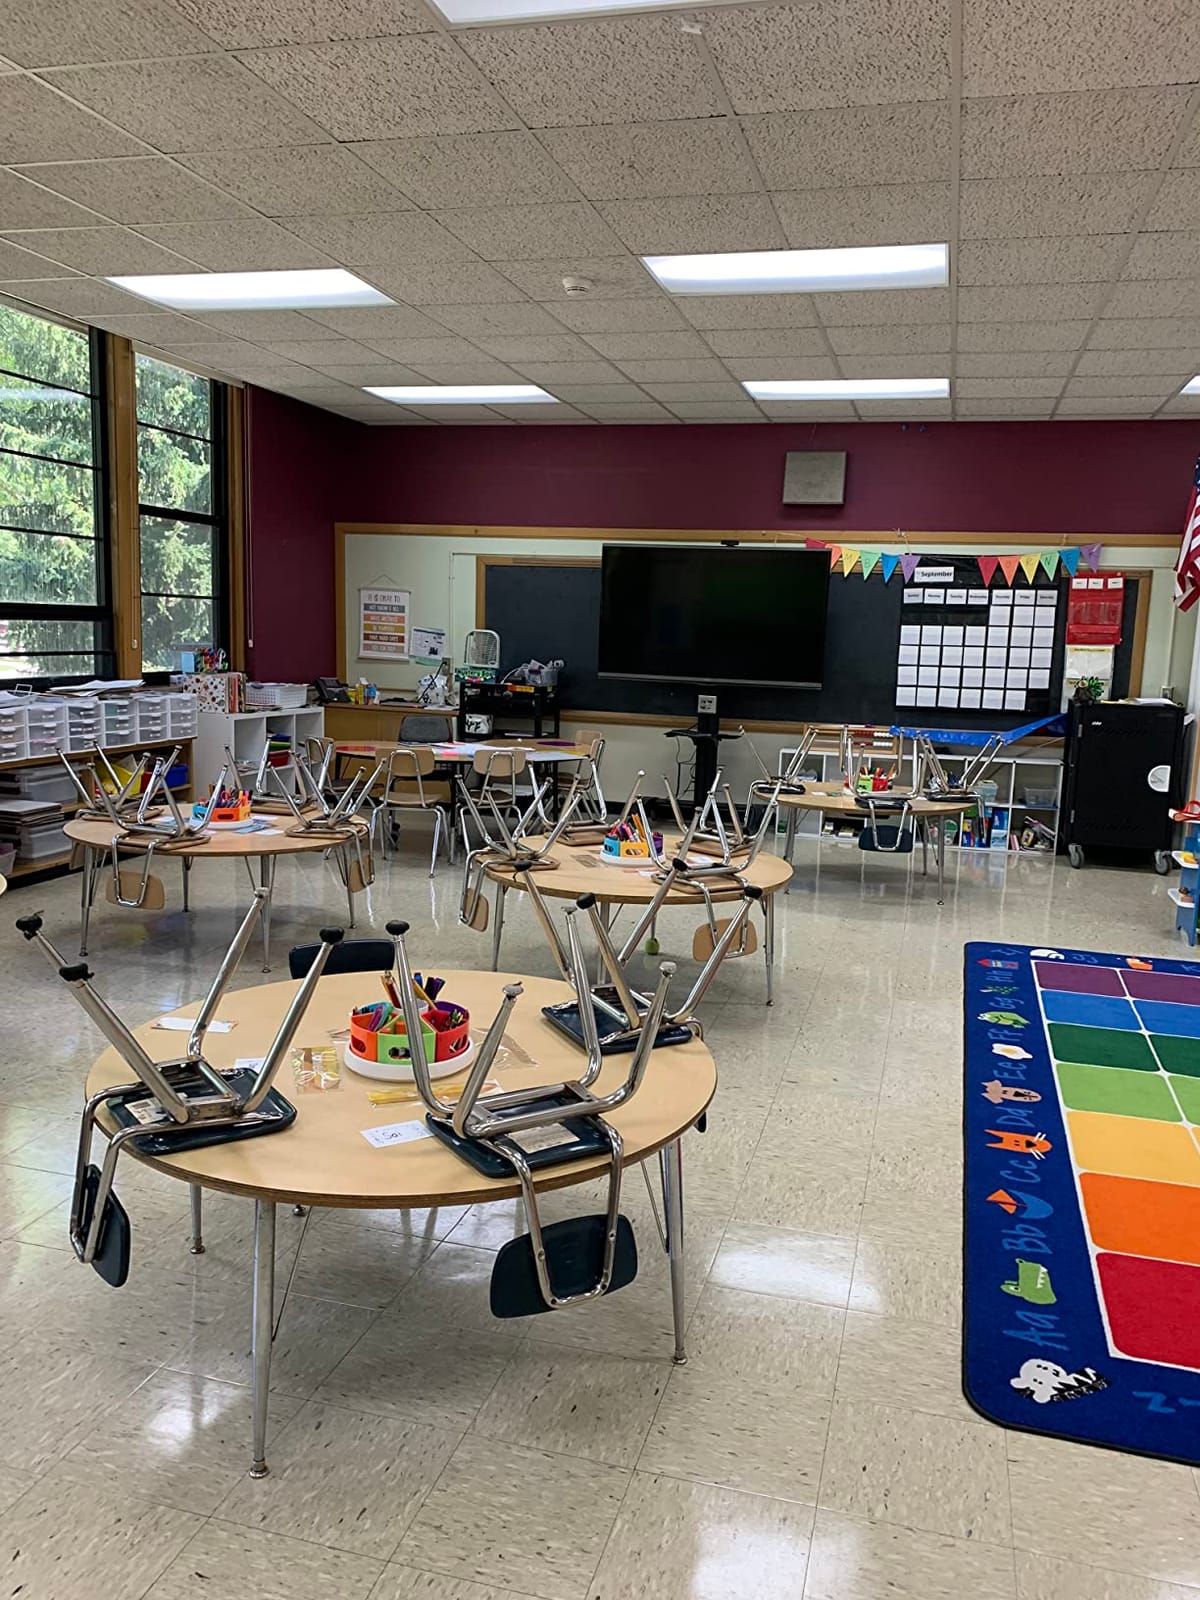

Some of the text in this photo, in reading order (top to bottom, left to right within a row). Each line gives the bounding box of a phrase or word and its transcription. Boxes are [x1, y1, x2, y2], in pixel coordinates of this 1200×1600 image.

[921, 570, 953, 579] September
[992, 1061, 1027, 1080] Ee
[995, 1105, 1035, 1128] Dd
[1000, 1159, 1041, 1184] Cc
[1001, 1223, 1053, 1254] Bb
[1002, 1310, 1071, 1350] Aa
